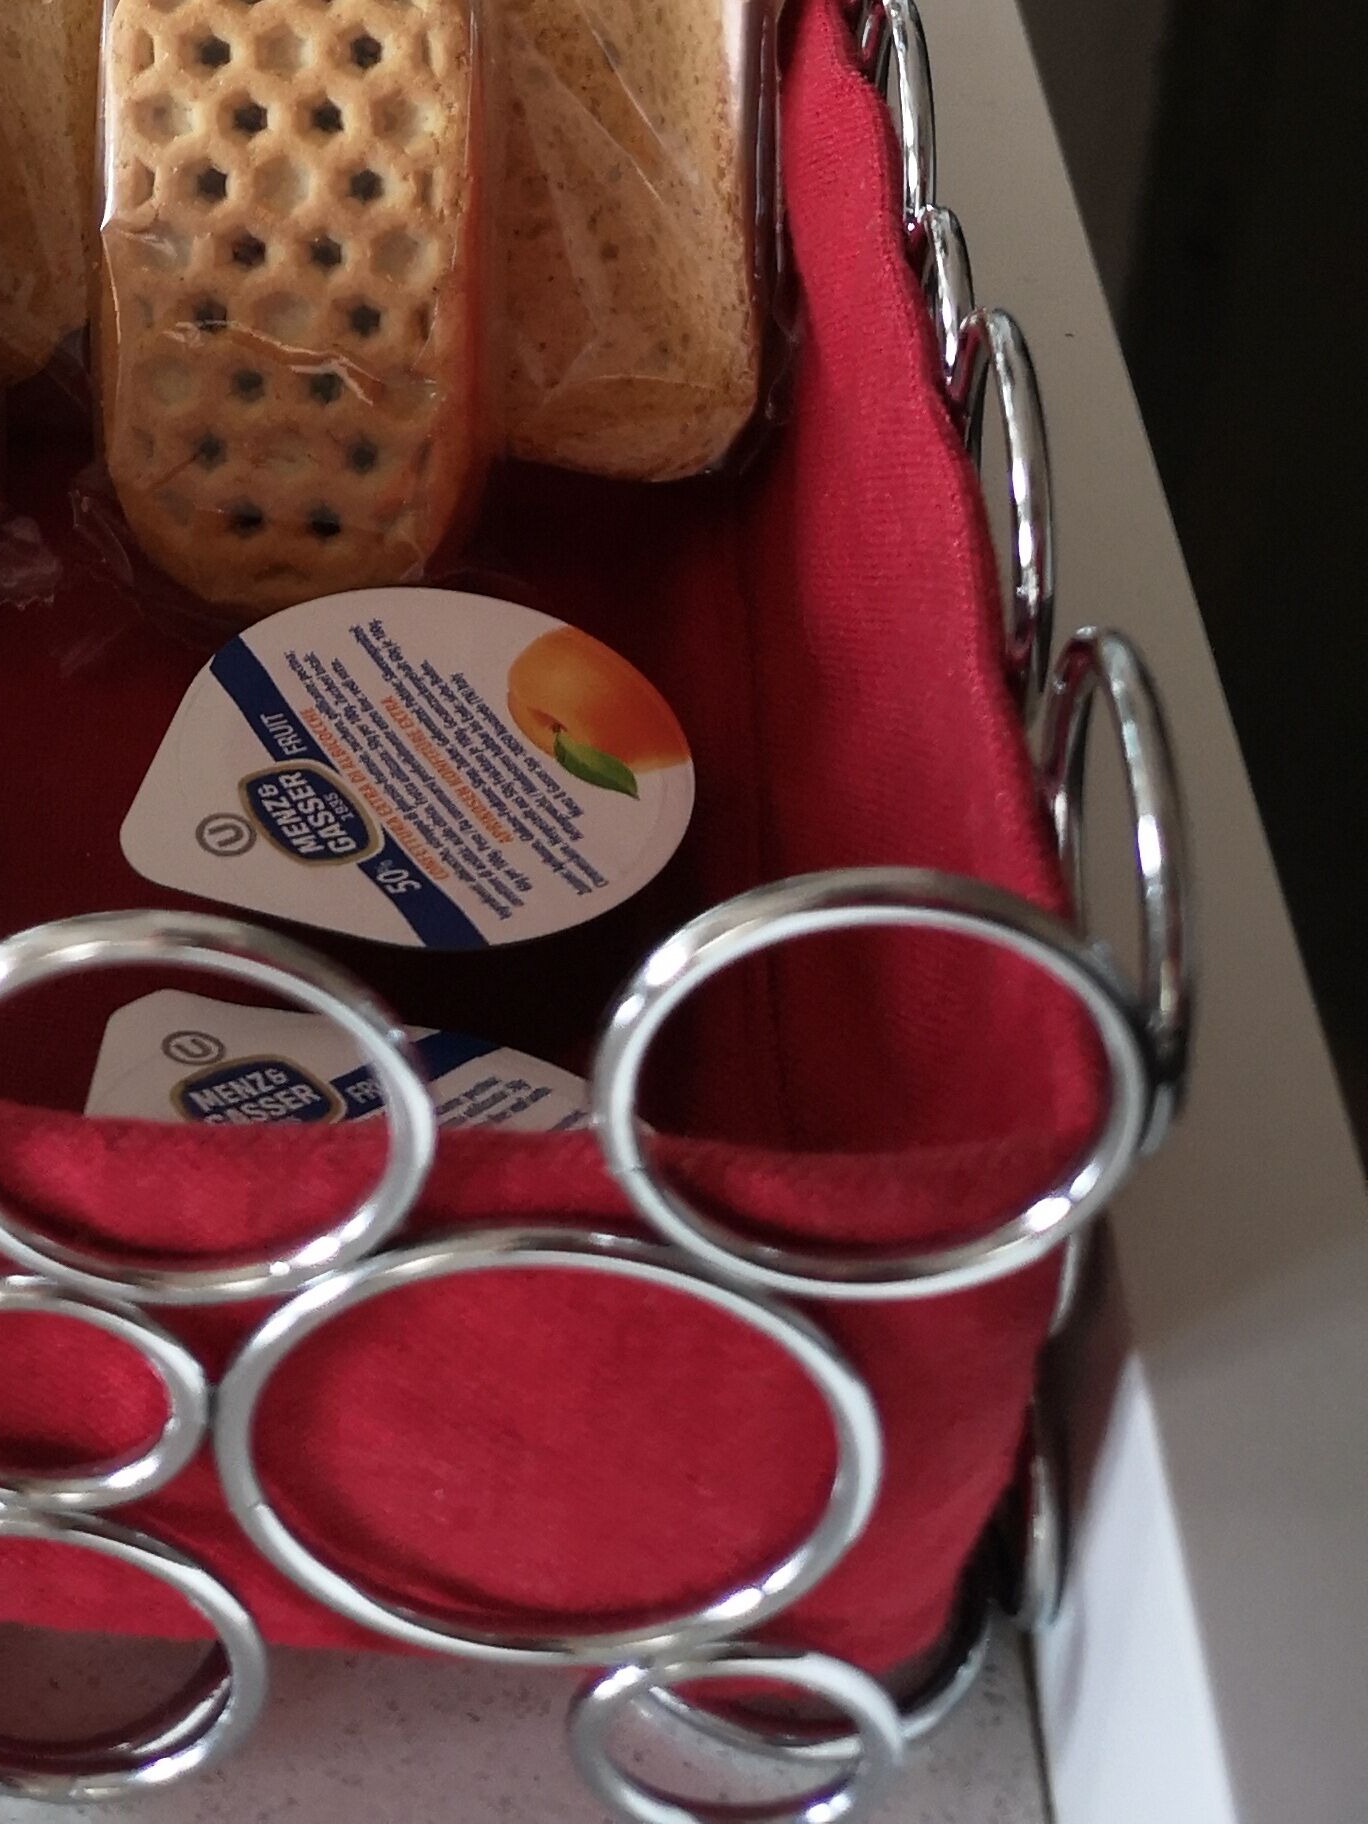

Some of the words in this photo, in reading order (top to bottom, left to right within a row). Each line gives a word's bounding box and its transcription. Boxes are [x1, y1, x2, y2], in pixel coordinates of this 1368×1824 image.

[258, 711, 309, 758] FRUIT
[297, 707, 357, 770] ALBICOCCHE
[375, 695, 417, 729] EXTRA
[345, 770, 368, 783] DI
[355, 783, 394, 816] EXTRA
[257, 782, 326, 855] MENZ&
[278, 769, 357, 854] GASSER
[452, 785, 514, 844] APRIKOSEN
[383, 815, 450, 881] CONFETTURA
[188, 1067, 288, 1112] MENZ&
